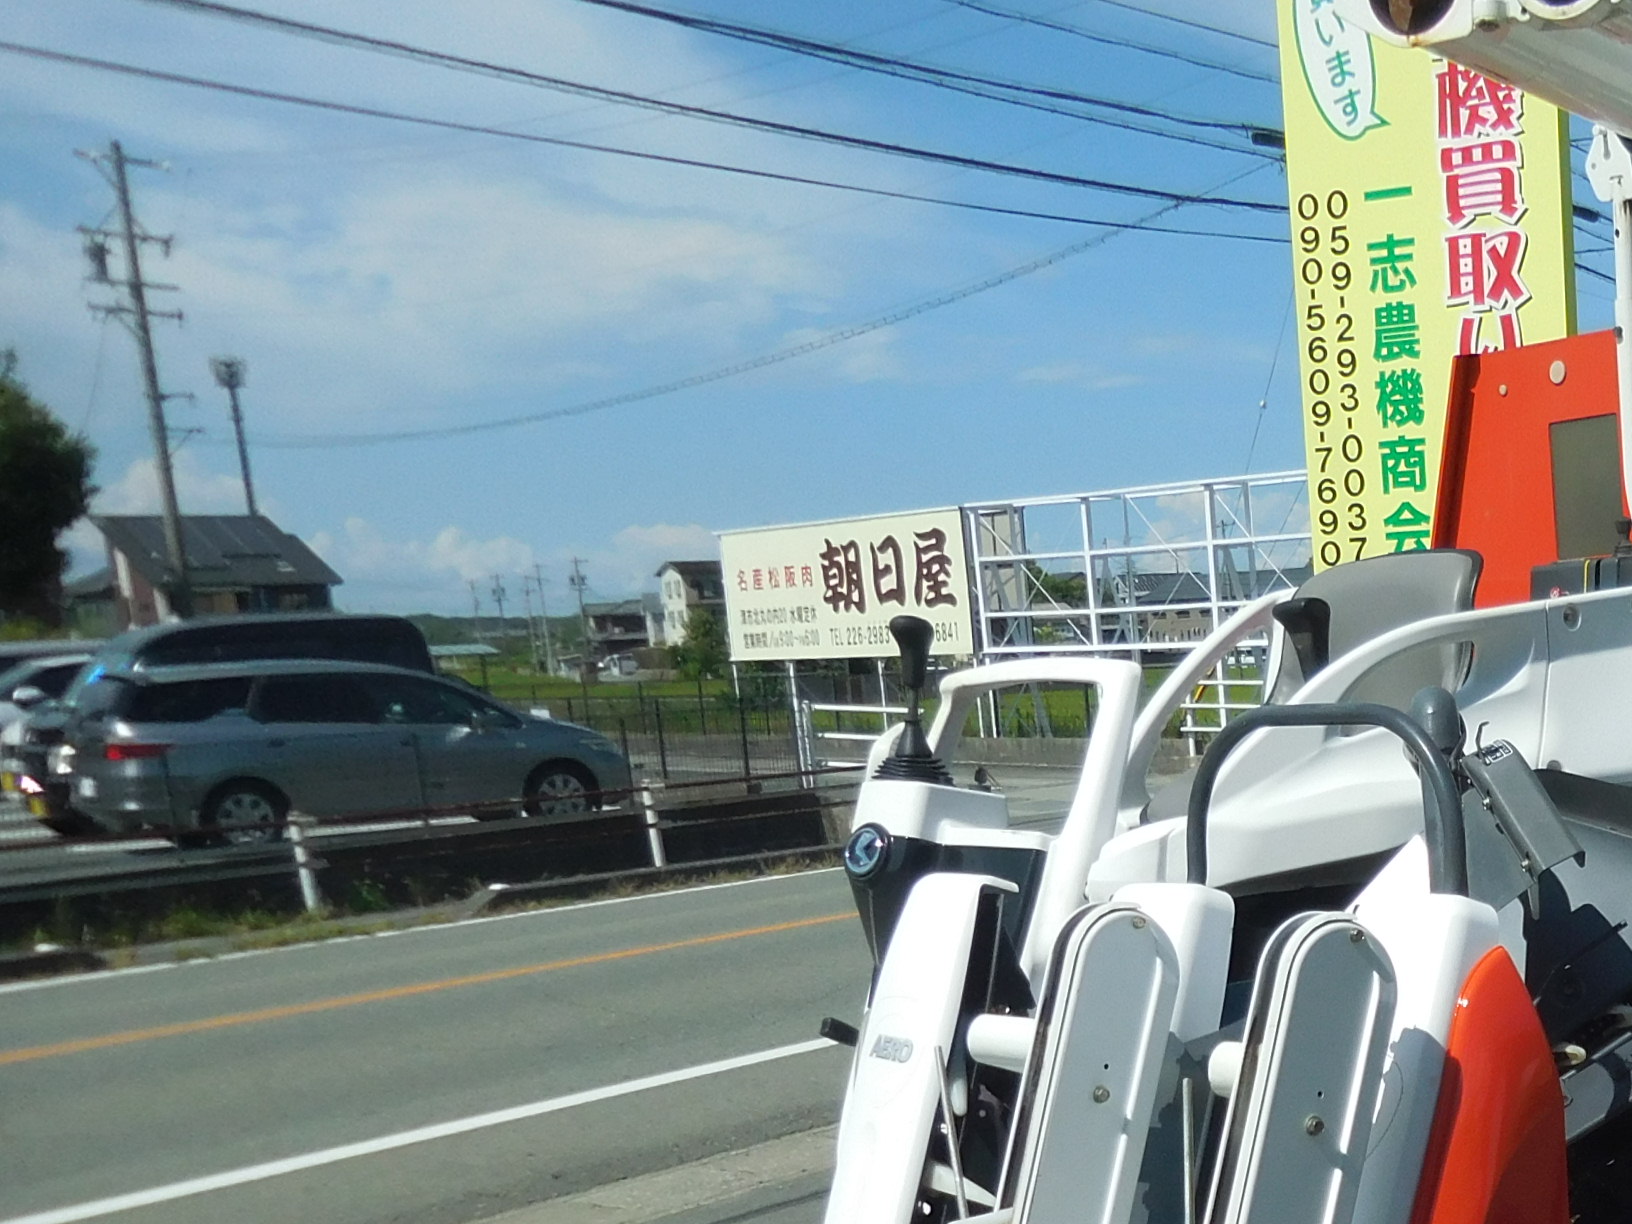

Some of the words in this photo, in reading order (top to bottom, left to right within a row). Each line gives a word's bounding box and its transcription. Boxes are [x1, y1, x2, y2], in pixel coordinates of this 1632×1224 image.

[1310, 0, 1361, 127] います
[1297, 193, 1342, 567] 090-5609-7690
[1326, 189, 1368, 562] 059-293-0037
[1363, 185, 1431, 553] 一志農機商会
[736, 564, 814, 592] 名産松阪肉
[819, 527, 958, 614] 朝日屋
[829, 627, 844, 646] TEL
[846, 625, 890, 646] 226-2983
[935, 621, 960, 643] 6841
[869, 1034, 914, 1064] AERO
